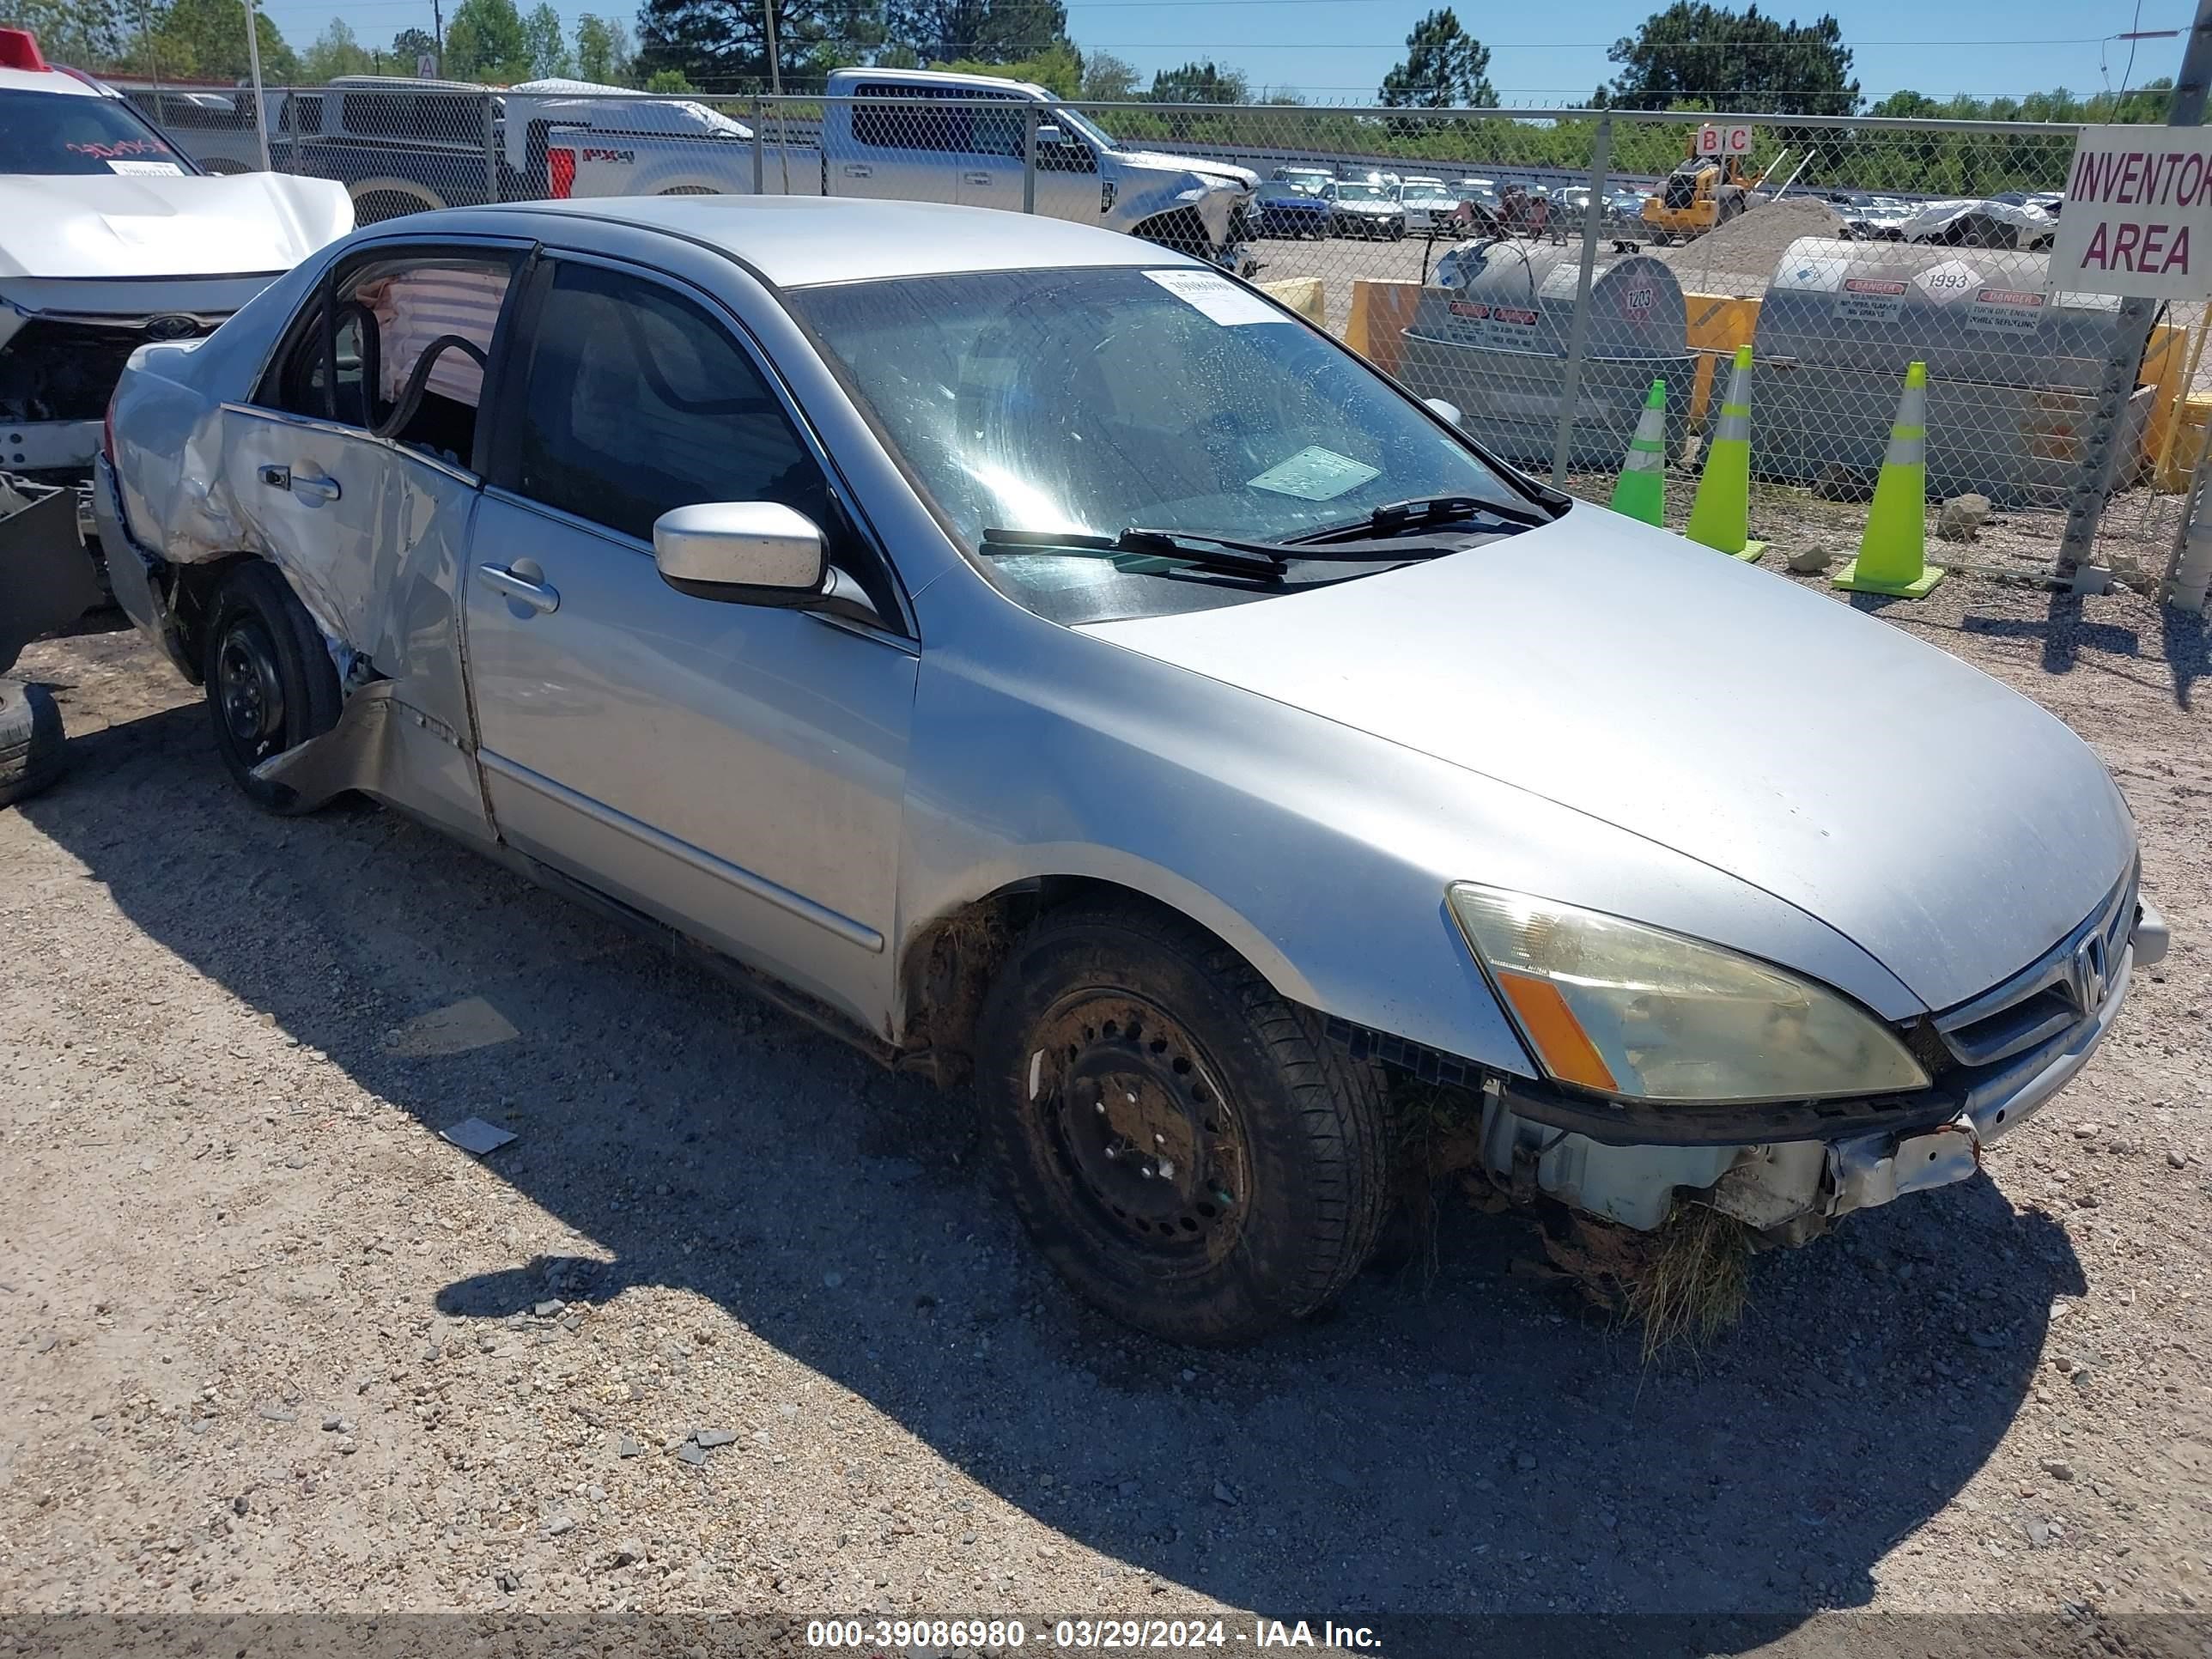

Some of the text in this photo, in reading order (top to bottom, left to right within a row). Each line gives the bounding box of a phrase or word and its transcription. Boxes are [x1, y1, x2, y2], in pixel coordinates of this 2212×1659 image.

[421, 58, 434, 77] A
[1704, 131, 1717, 150] B
[1731, 130, 1746, 150] C
[2080, 222, 2190, 276] AREA
[1854, 281, 1896, 292] DANGER
[1929, 274, 1967, 289] 1993
[1629, 289, 1650, 307] 1203
[1989, 290, 2033, 304] DANGER
